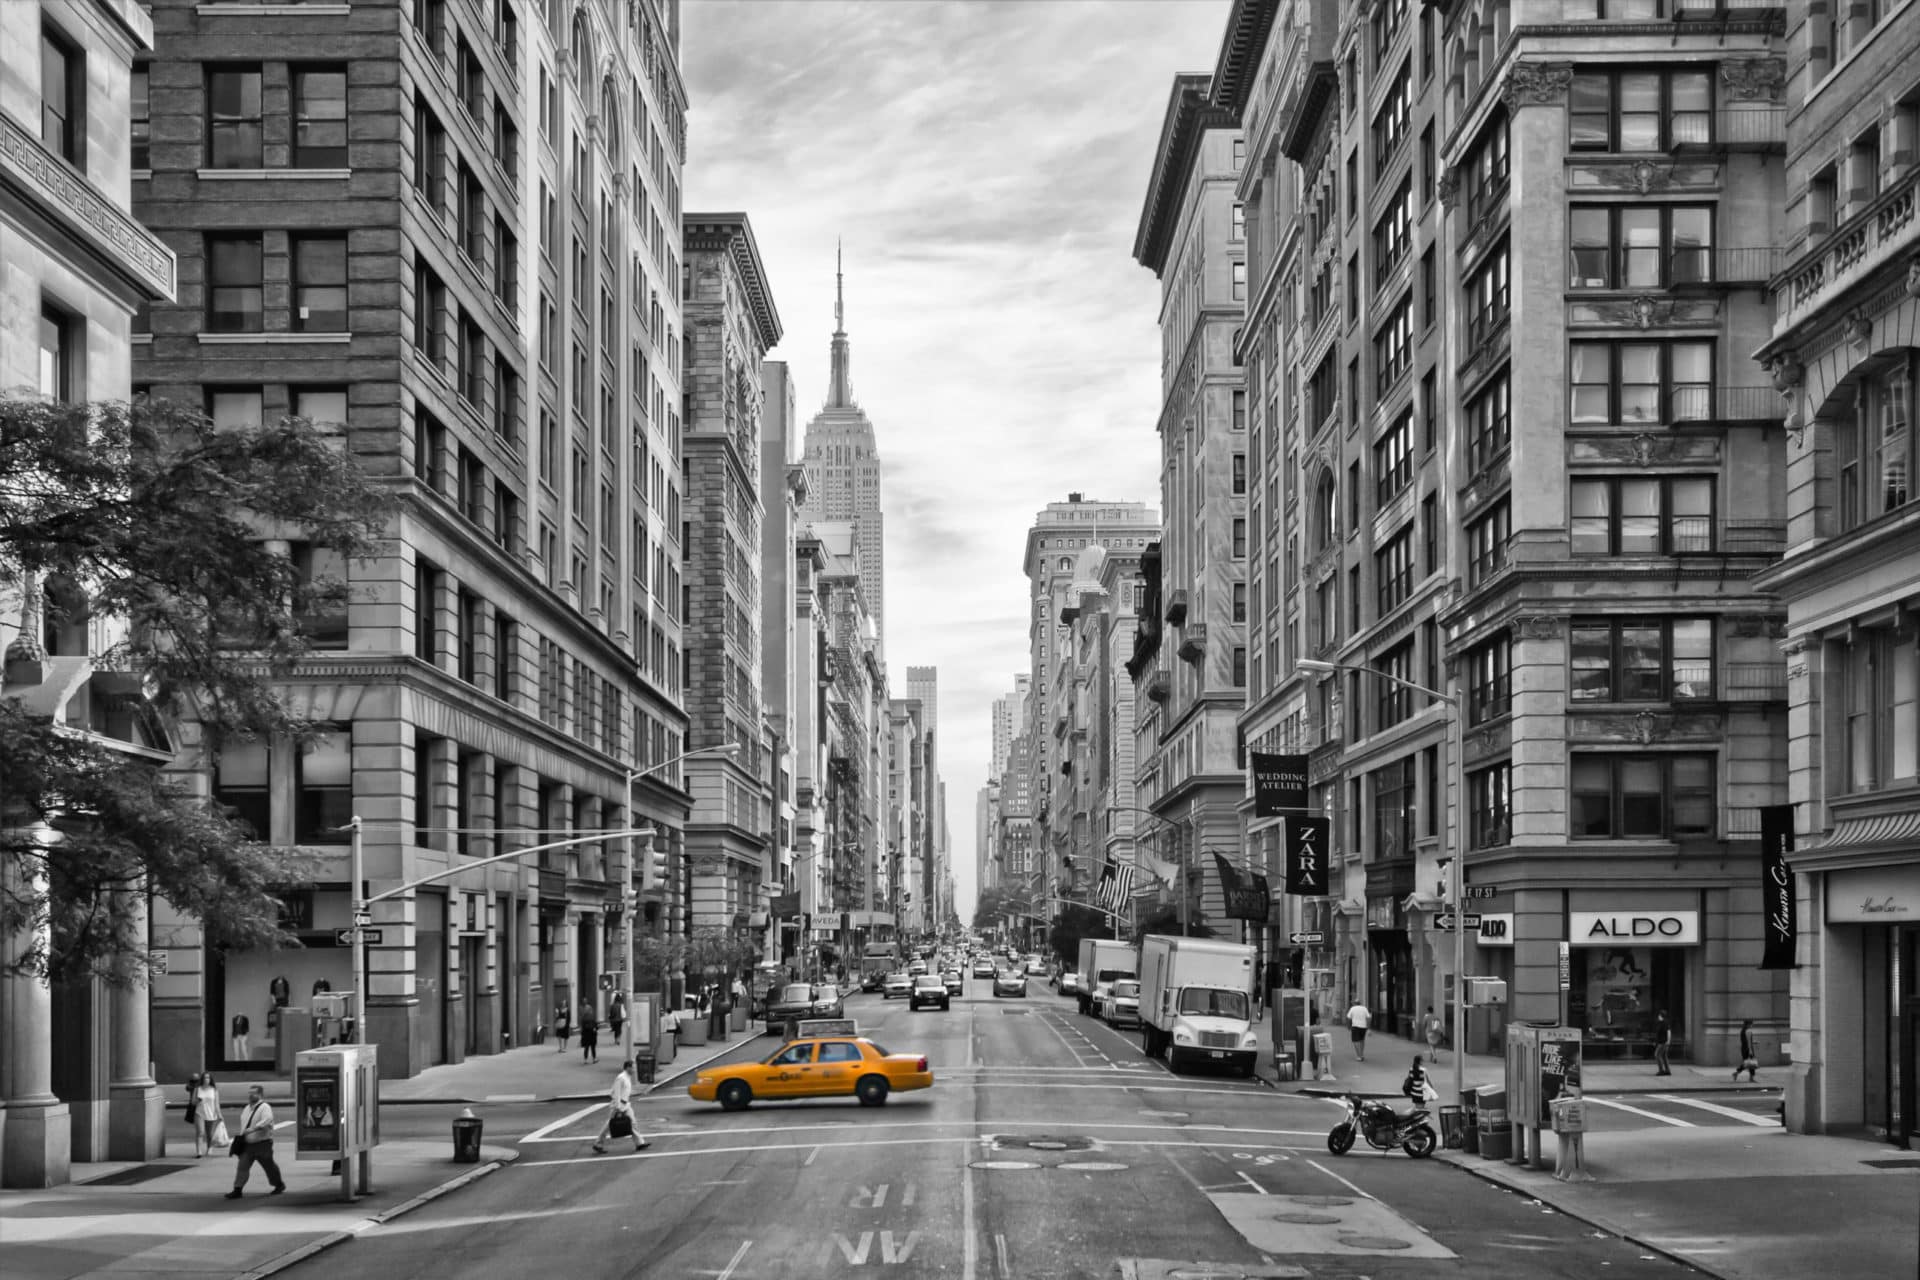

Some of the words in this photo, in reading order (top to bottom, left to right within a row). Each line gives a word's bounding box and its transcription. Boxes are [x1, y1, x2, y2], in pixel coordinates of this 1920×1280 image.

[1257, 773, 1306, 782] WEDDING
[1261, 782, 1303, 790] ATELIER
[1299, 827, 1316, 886] ZARA
[1467, 888, 1473, 898] E
[1475, 888, 1482, 898] 17
[1485, 887, 1493, 898] ST
[812, 917, 840, 925] AVEDA
[1481, 919, 1506, 937] ALDO
[1588, 917, 1683, 937] ALDO
[1544, 1055, 1563, 1065] LIKE
